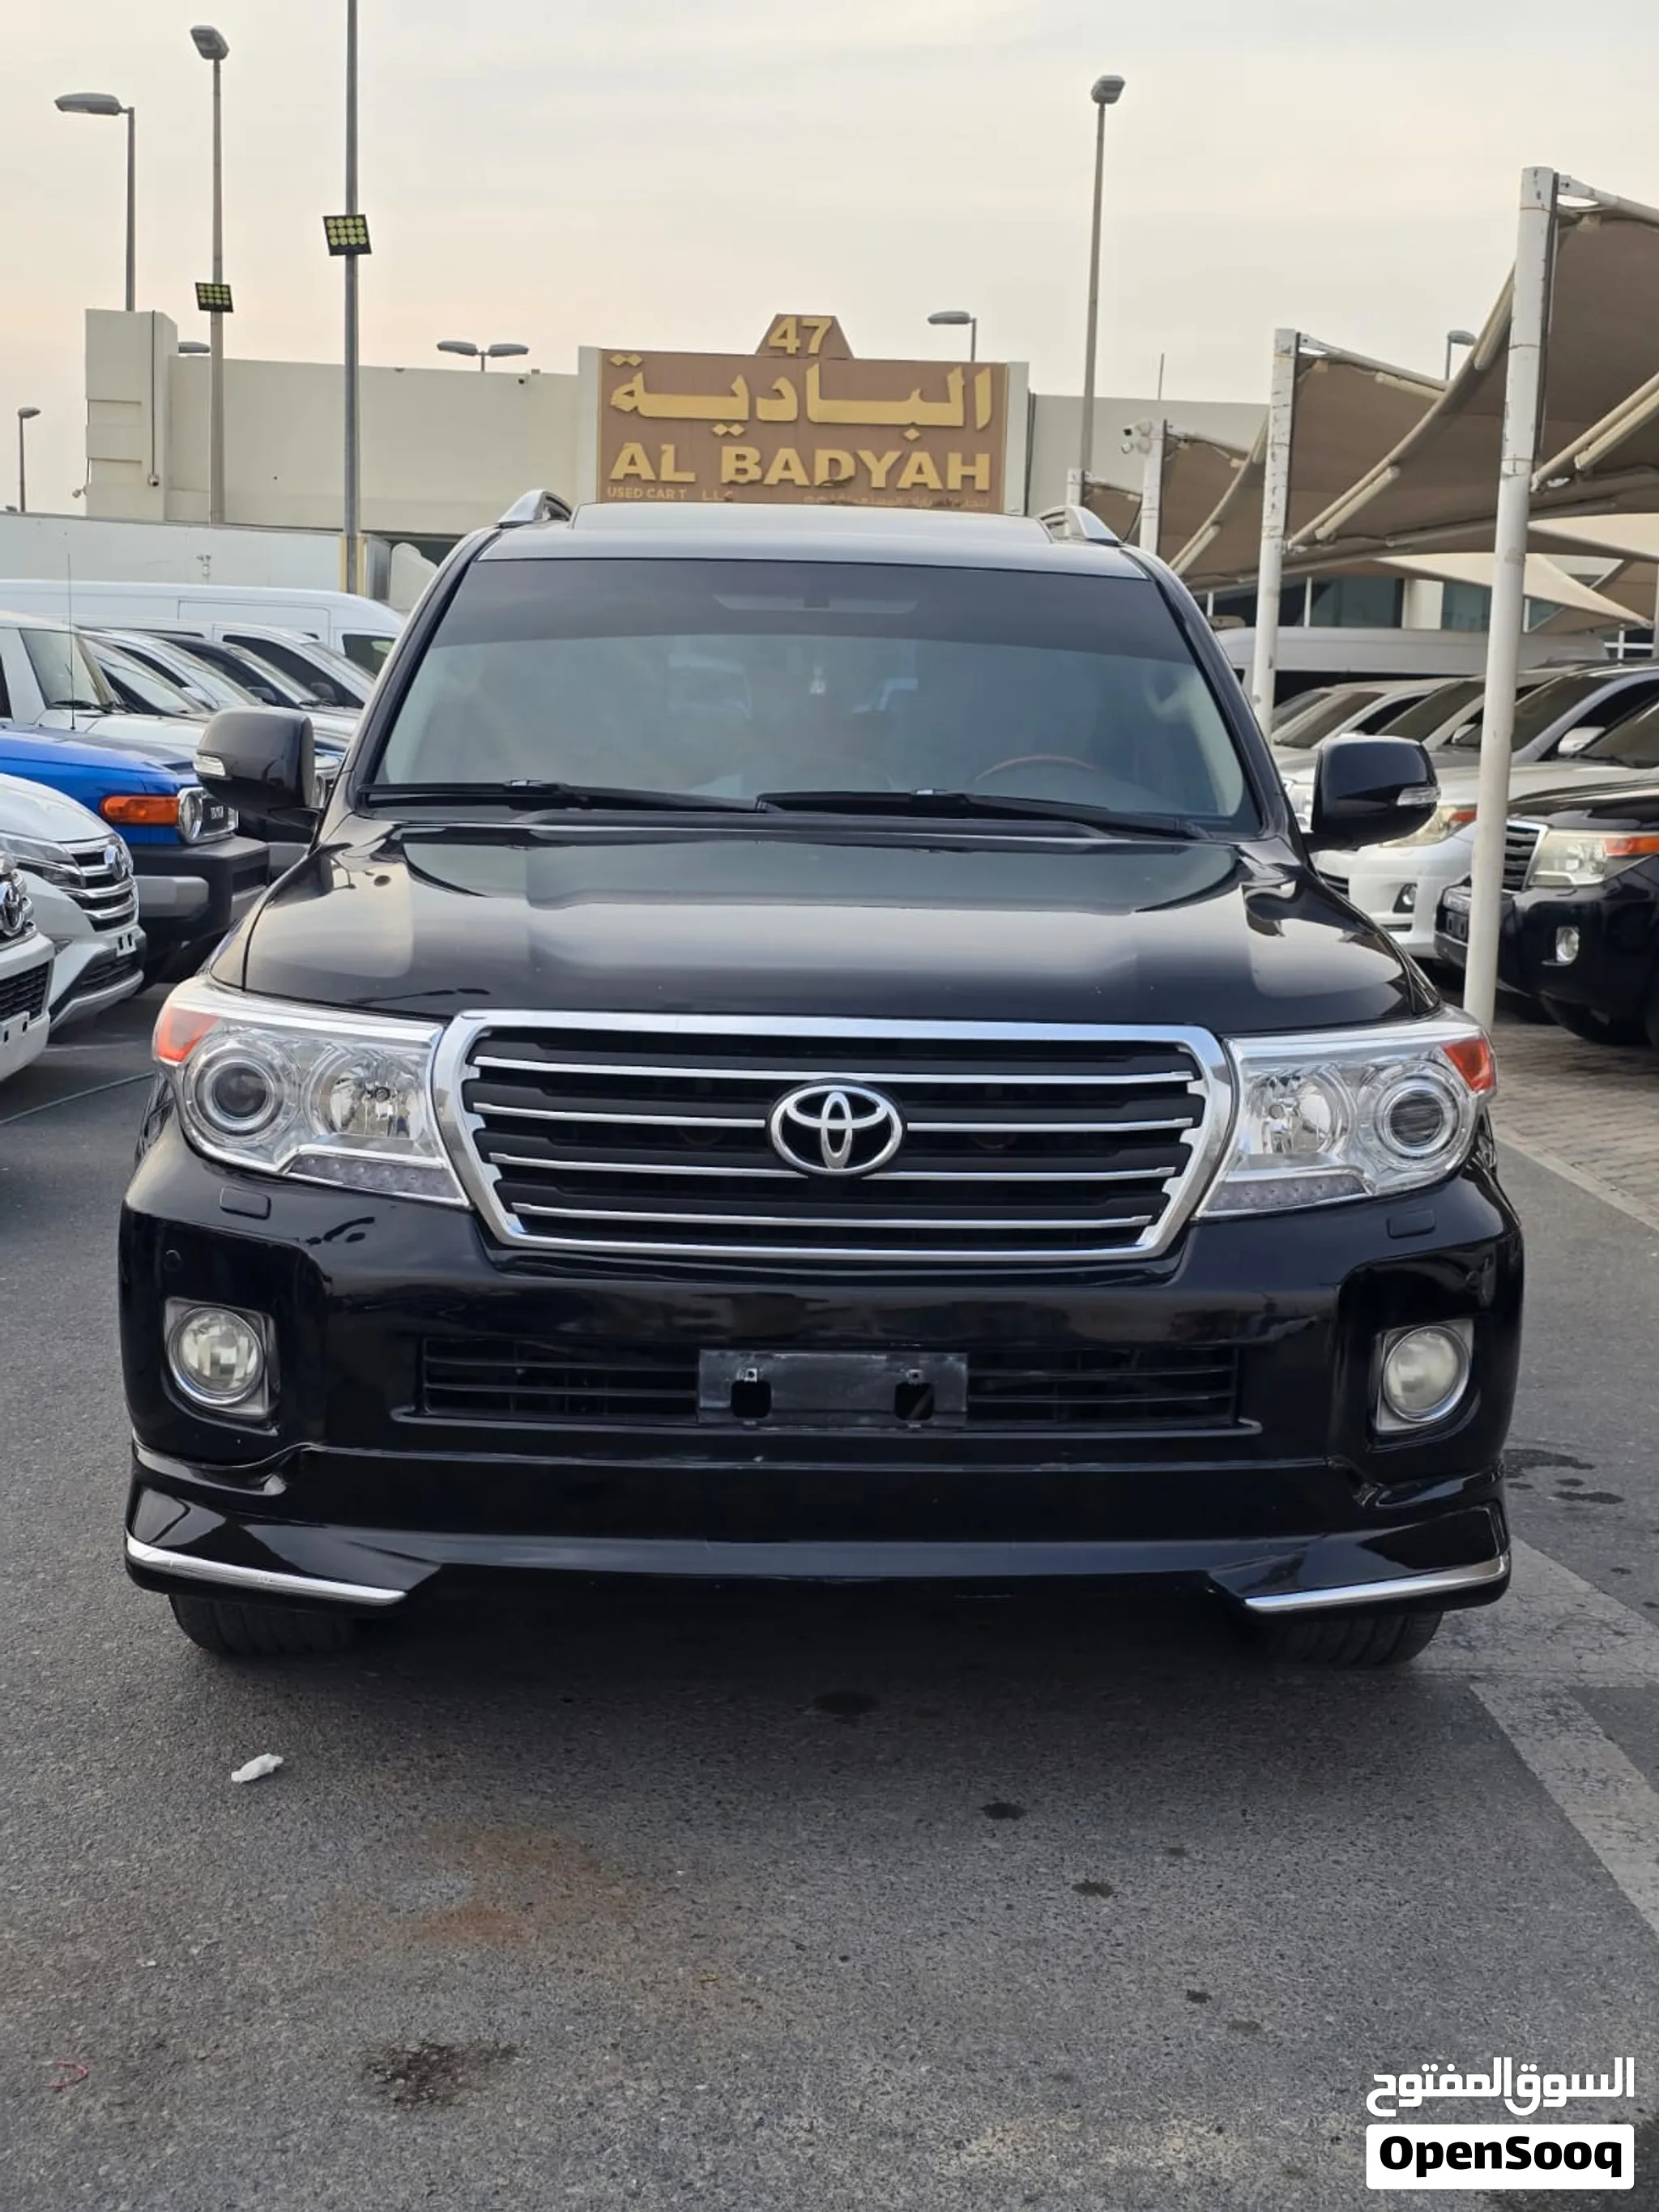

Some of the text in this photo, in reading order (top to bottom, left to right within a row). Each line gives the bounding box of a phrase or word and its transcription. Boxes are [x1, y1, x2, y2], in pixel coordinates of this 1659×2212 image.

[768, 316, 833, 355] 47
[609, 353, 992, 441] البادية
[609, 442, 991, 491] AL BADYAH
[607, 486, 643, 500] USED
[646, 488, 676, 500] CAR
